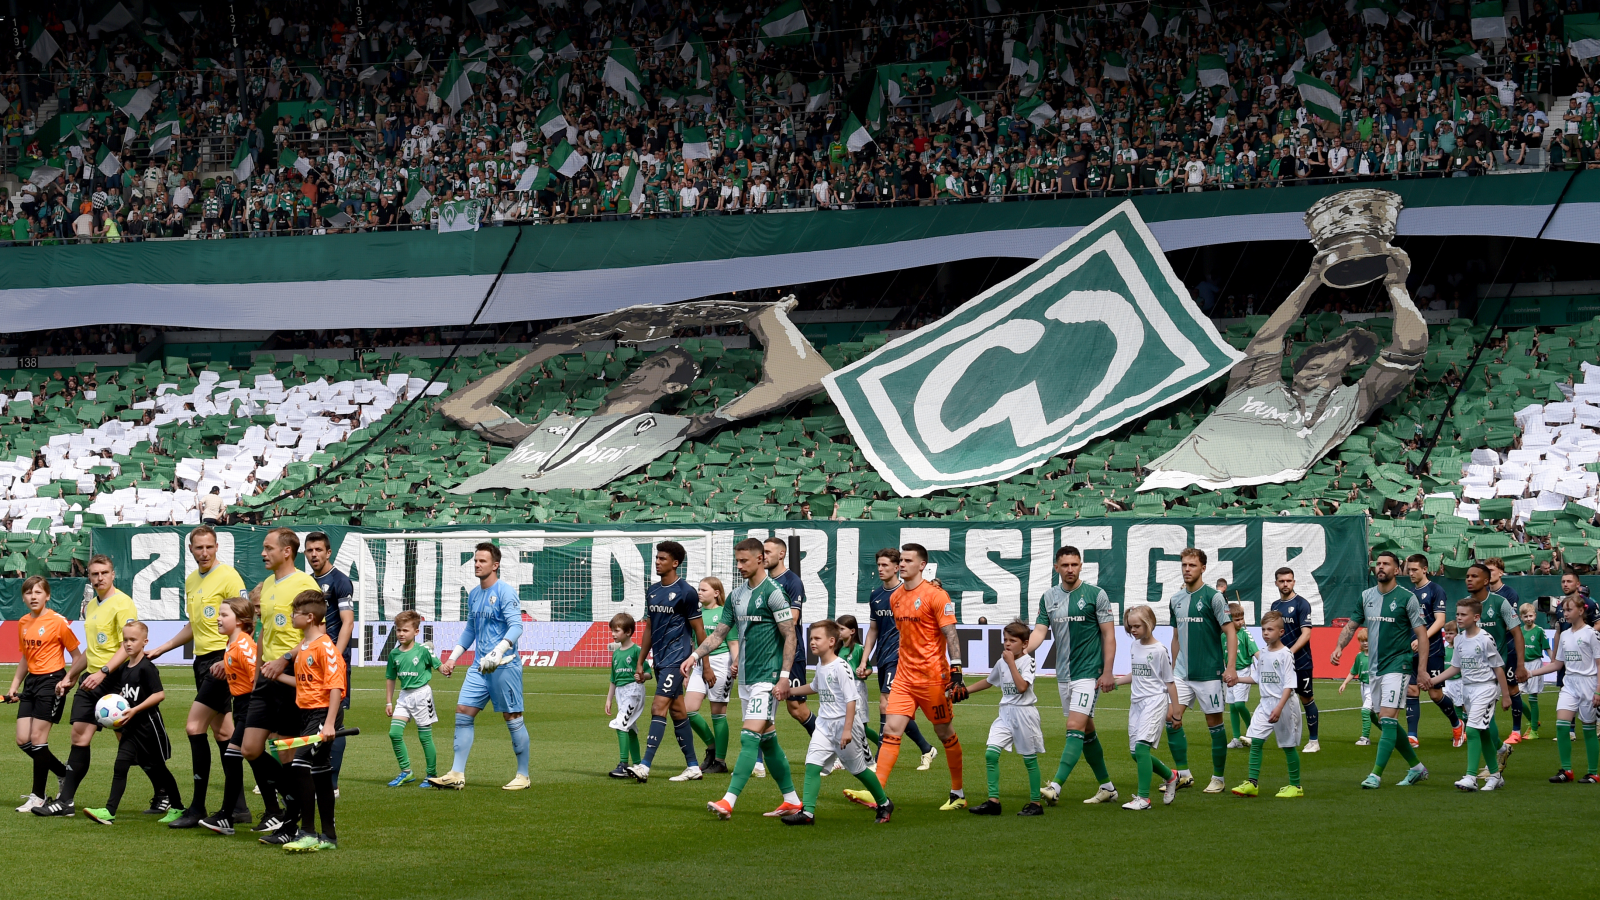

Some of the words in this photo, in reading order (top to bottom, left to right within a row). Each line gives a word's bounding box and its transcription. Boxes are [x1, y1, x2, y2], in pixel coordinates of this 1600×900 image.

[12, 17, 20, 46] 139
[18, 357, 37, 368] 138
[295, 530, 551, 622] AHRE
[777, 611, 790, 620] SVW
[521, 650, 560, 667] rtal
[1506, 666, 1514, 678] 6
[663, 674, 674, 688] 5
[1302, 677, 1310, 690] 7
[121, 683, 140, 702] sky
[1003, 687, 1019, 695] STRO
[1388, 690, 1396, 703] 3
[750, 699, 762, 714] 32
[1078, 693, 1089, 707] 13
[1209, 694, 1220, 708] 14
[932, 704, 945, 720] 30
